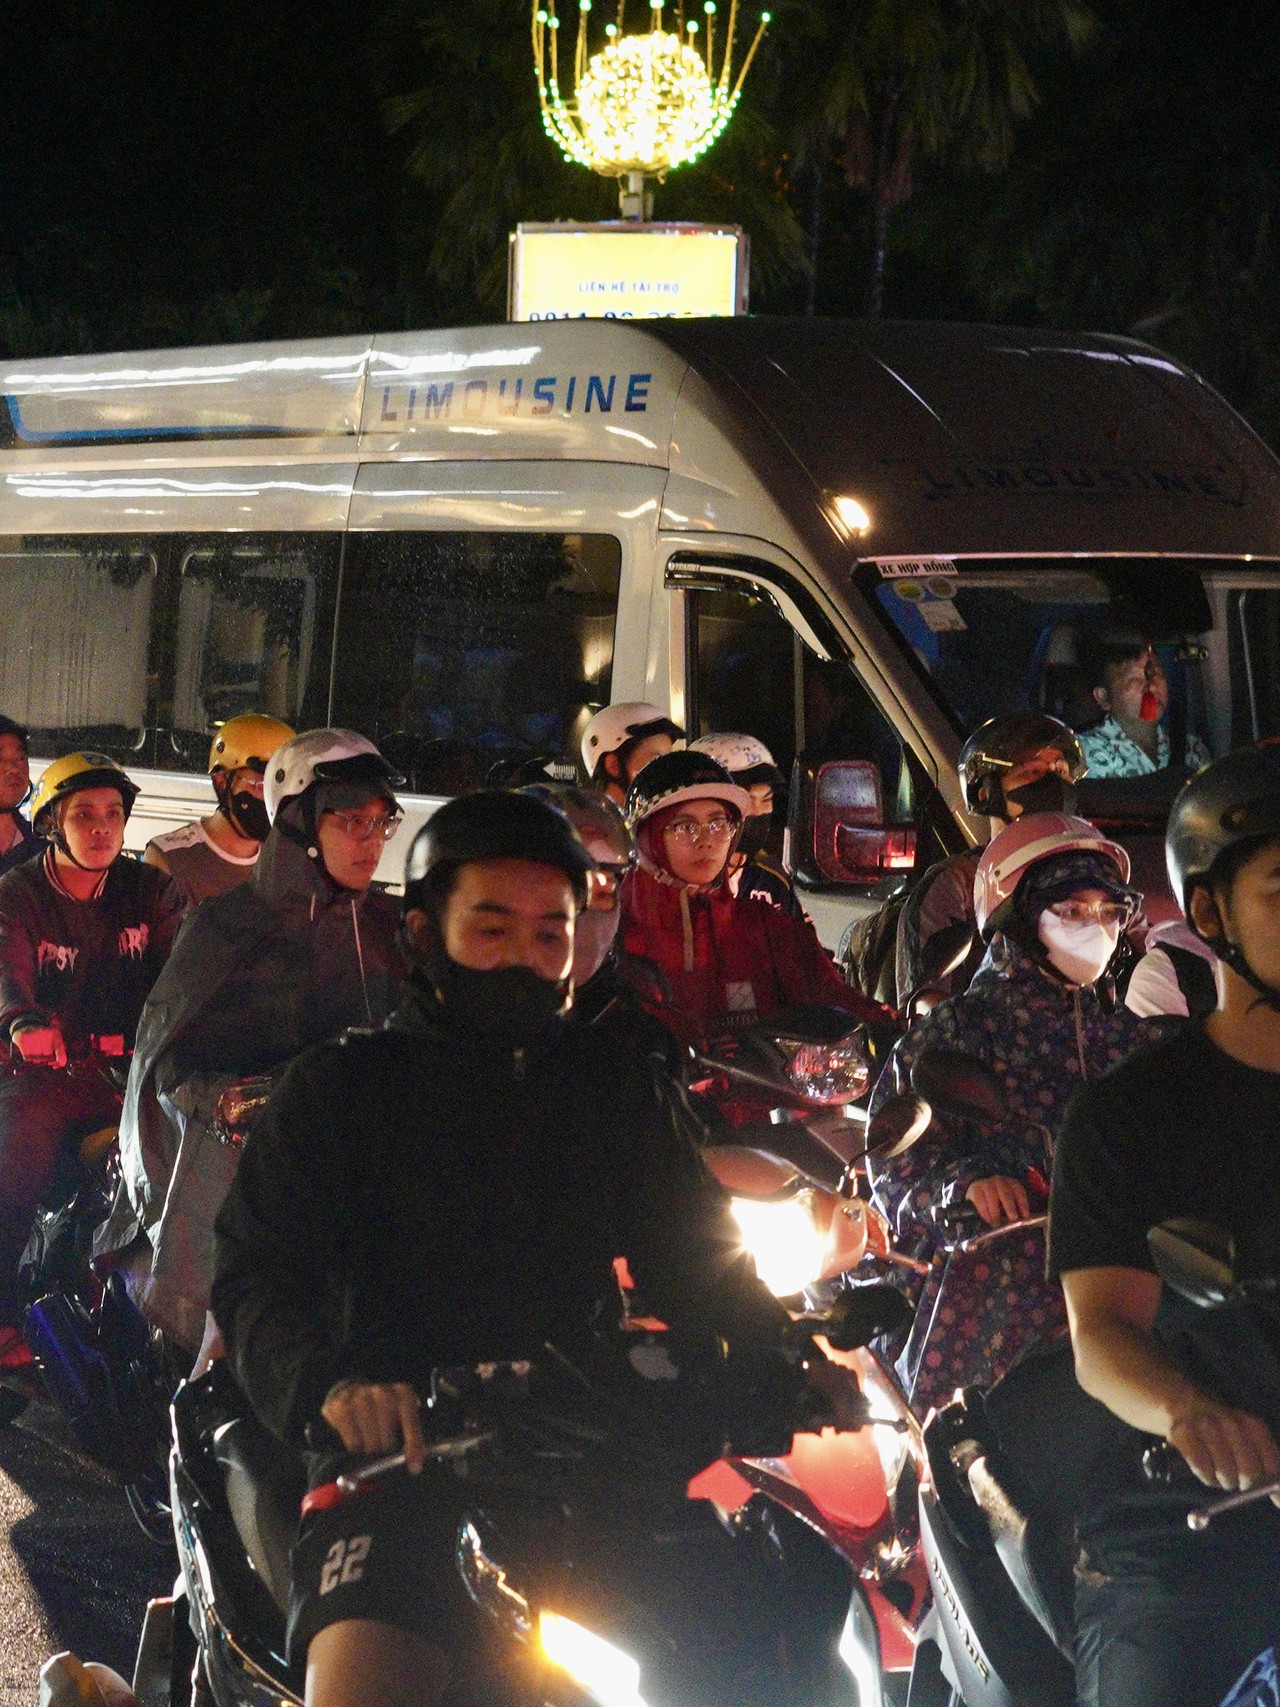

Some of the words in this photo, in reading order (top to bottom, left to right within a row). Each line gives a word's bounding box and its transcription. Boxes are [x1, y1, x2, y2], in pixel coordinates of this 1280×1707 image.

[579, 282, 605, 293] LIÊN
[632, 282, 650, 293] TÀI
[380, 373, 652, 422] LIMOUSINE
[880, 564, 896, 575] XE
[320, 1536, 372, 1596] 22
